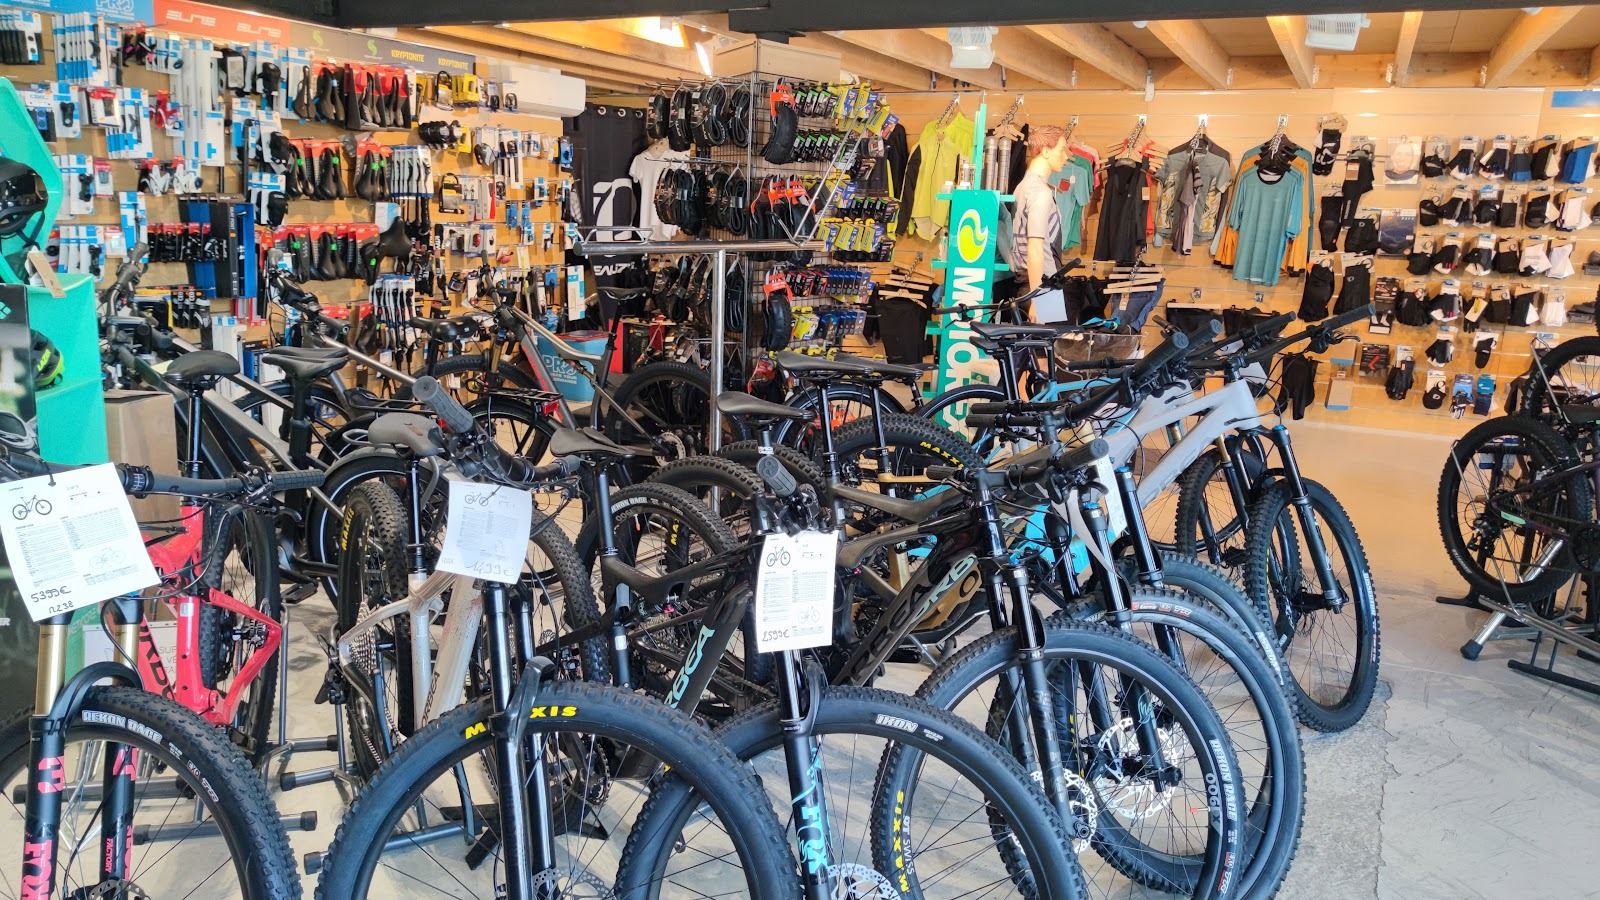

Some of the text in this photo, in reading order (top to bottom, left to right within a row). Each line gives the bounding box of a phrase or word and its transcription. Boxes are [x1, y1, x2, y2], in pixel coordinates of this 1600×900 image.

[391, 49, 425, 63] KRYPTONITE
[438, 57, 469, 71] KRYPTONITE
[920, 441, 965, 471] MAXXI
[664, 624, 716, 710] RBEA
[82, 709, 163, 745] REKON RACE
[465, 705, 578, 740] MXIS
[875, 713, 919, 734] IKON
[1208, 738, 1233, 784] REKON
[1223, 783, 1238, 822] RACE
[105, 837, 114, 873] FACTORY
[893, 789, 910, 894] MAXXIS
[902, 838, 915, 876] SWISS
